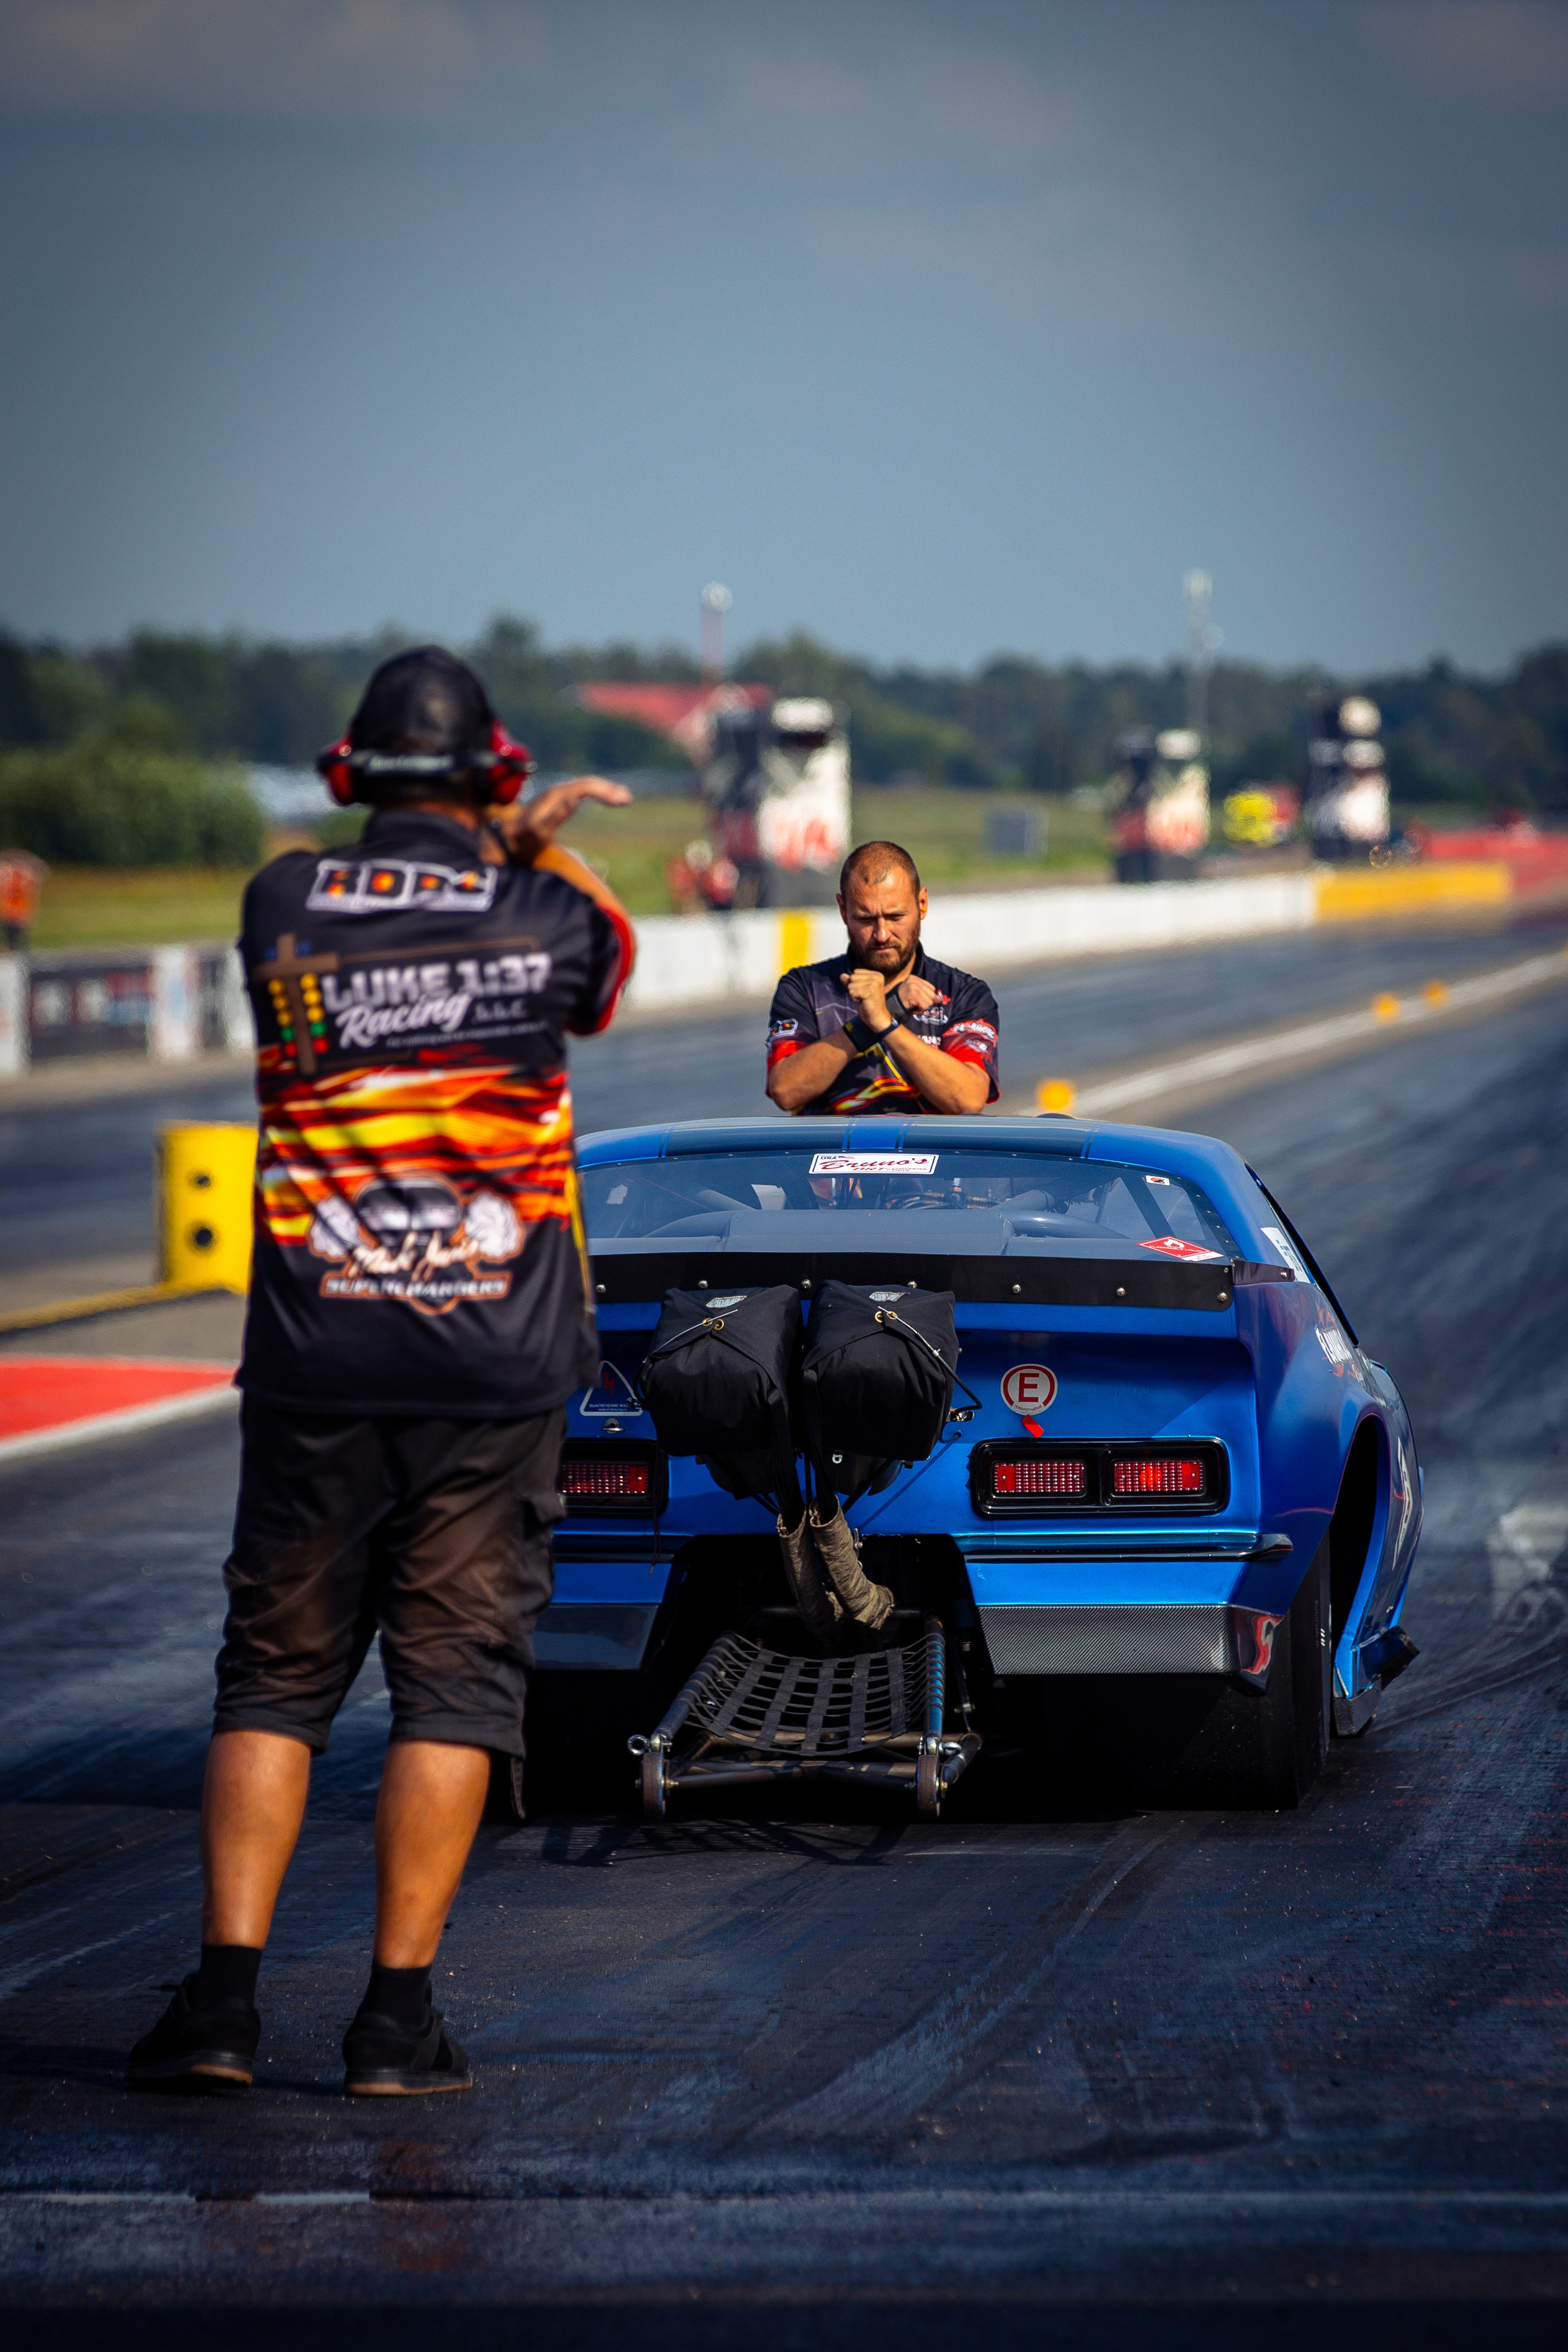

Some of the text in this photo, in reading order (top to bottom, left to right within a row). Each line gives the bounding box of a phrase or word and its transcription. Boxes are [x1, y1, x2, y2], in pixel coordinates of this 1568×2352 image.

[321, 952, 551, 1012] LUKE 1:37
[336, 993, 472, 1048] Racing
[819, 1158, 928, 1170] Bruno's
[326, 1280, 505, 1297] SUPERCHARGERS
[1019, 1373, 1039, 1402] E
